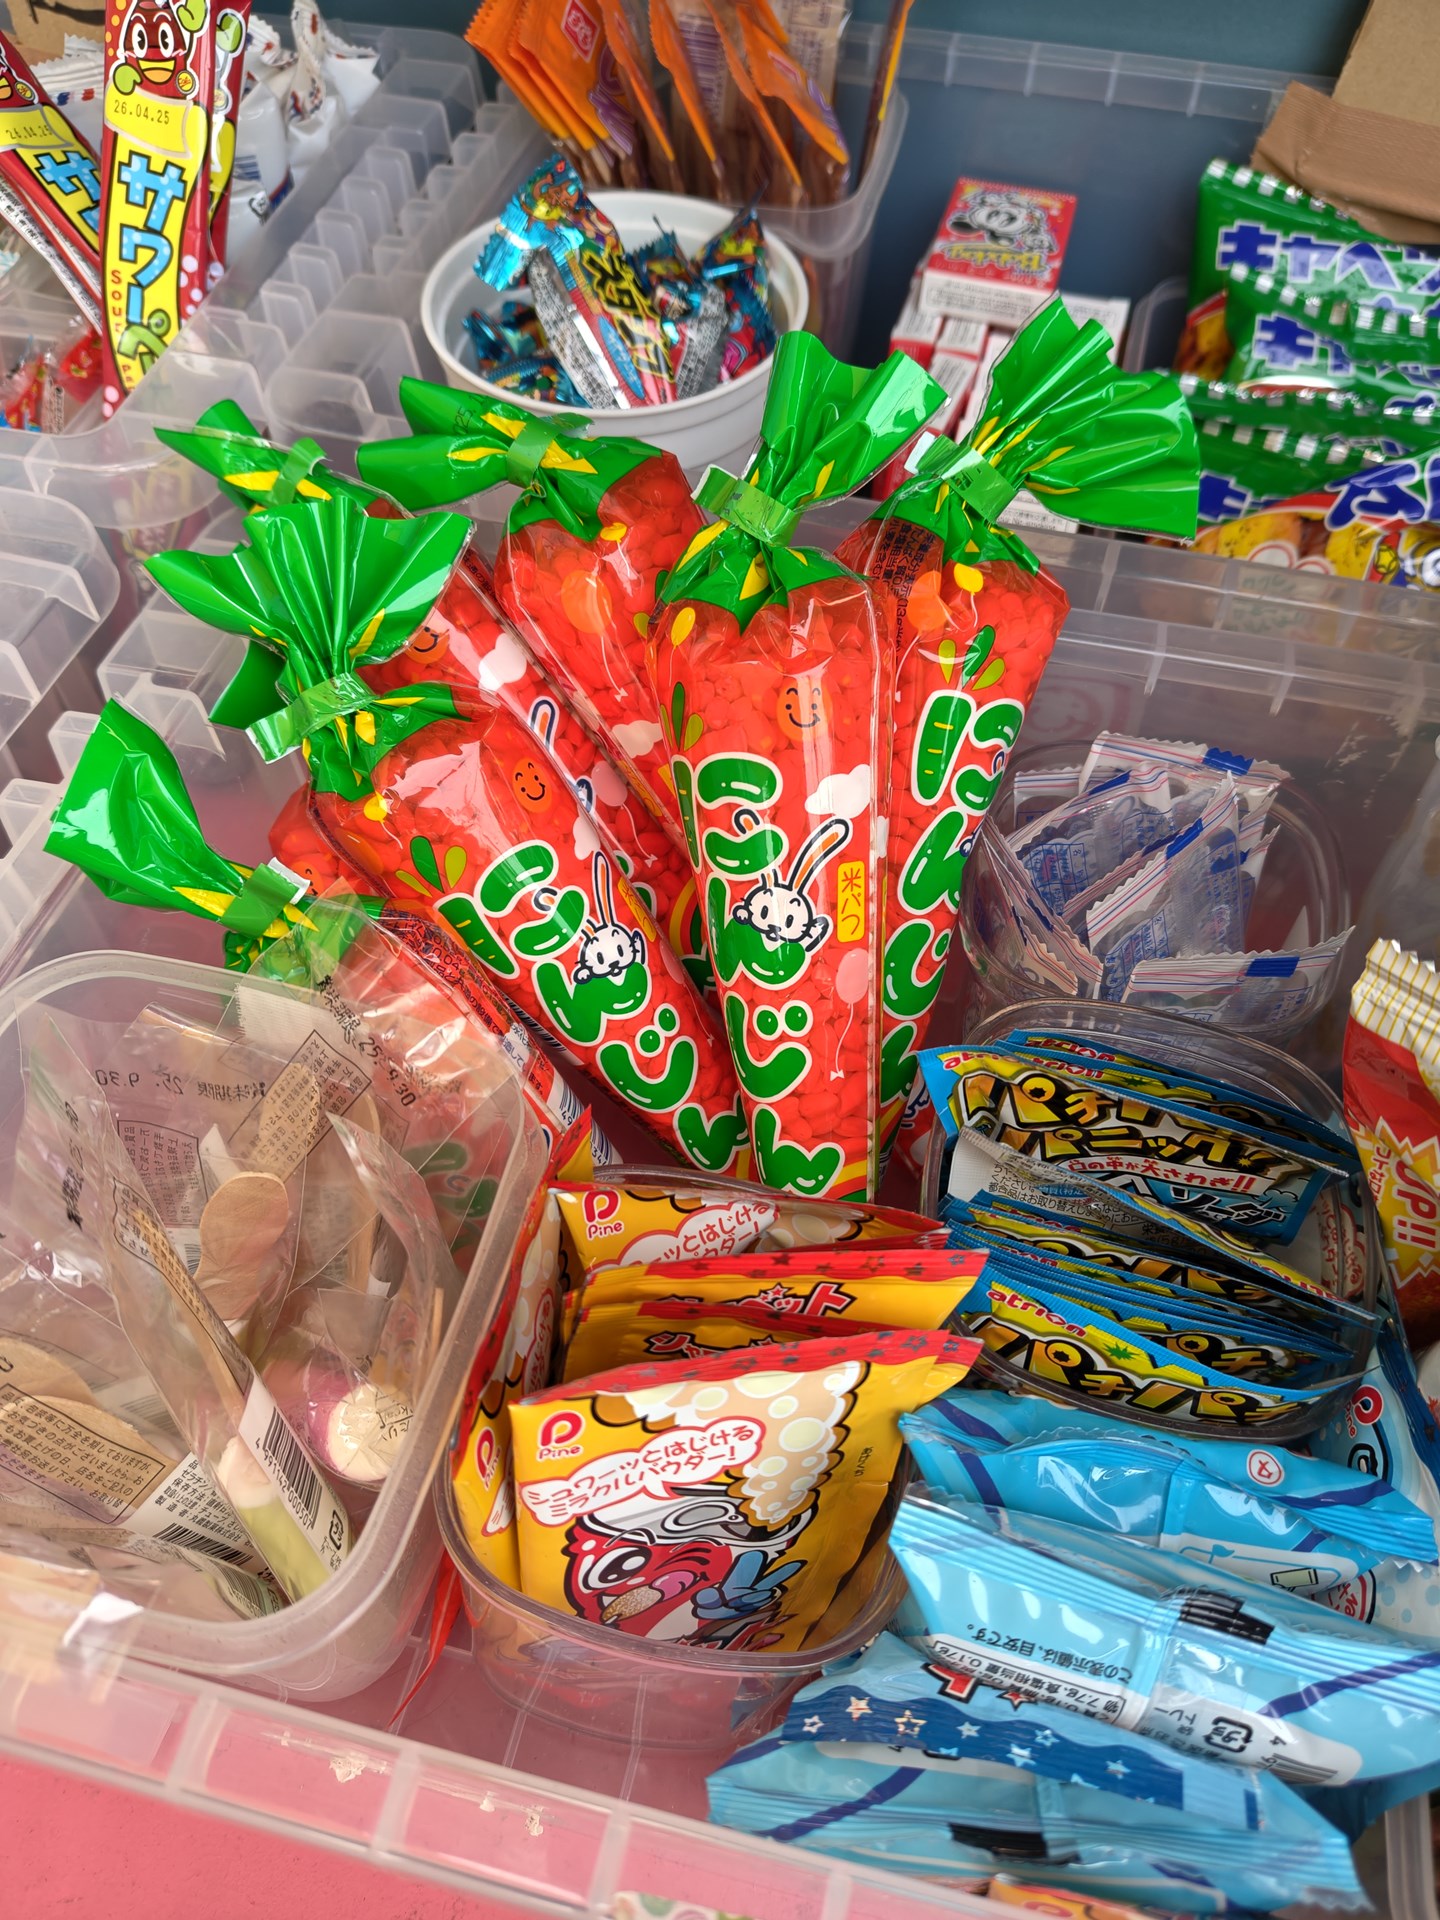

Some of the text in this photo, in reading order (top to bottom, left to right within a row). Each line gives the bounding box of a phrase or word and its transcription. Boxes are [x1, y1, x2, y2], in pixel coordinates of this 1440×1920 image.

[114, 98, 171, 126] 26.04.25
[670, 752, 846, 1199] にんじん
[587, 1220, 624, 1240] Pine
[986, 1287, 1088, 1339] atrion
[526, 1424, 755, 1506] シュワーッとはじける
[538, 1445, 582, 1461] Pine
[287, 1488, 313, 1531] 000507
[963, 1622, 1134, 1685] この表示値は、目安です。
